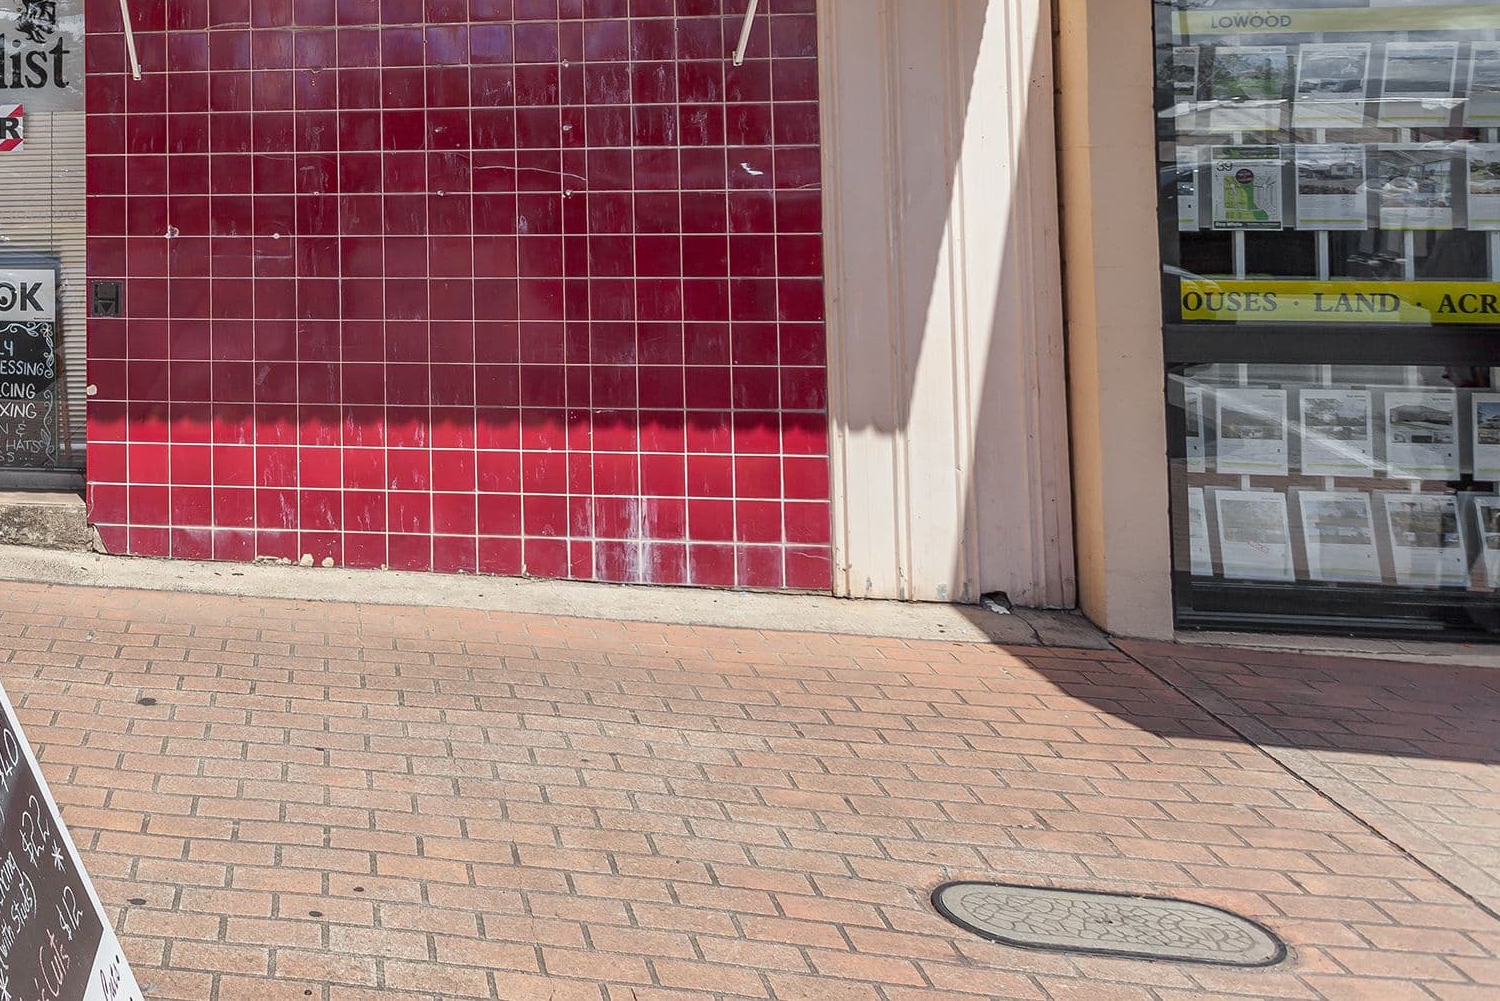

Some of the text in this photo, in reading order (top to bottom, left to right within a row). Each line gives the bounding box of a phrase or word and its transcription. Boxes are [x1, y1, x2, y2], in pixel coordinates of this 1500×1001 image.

[1211, 15, 1292, 29] LOWOOD
[1182, 291, 1277, 313] OUSES
[1314, 292, 1400, 313] LAND
[5, 439, 41, 454] HATS
[19, 794, 51, 870] $22
[40, 928, 71, 998] Cuts
